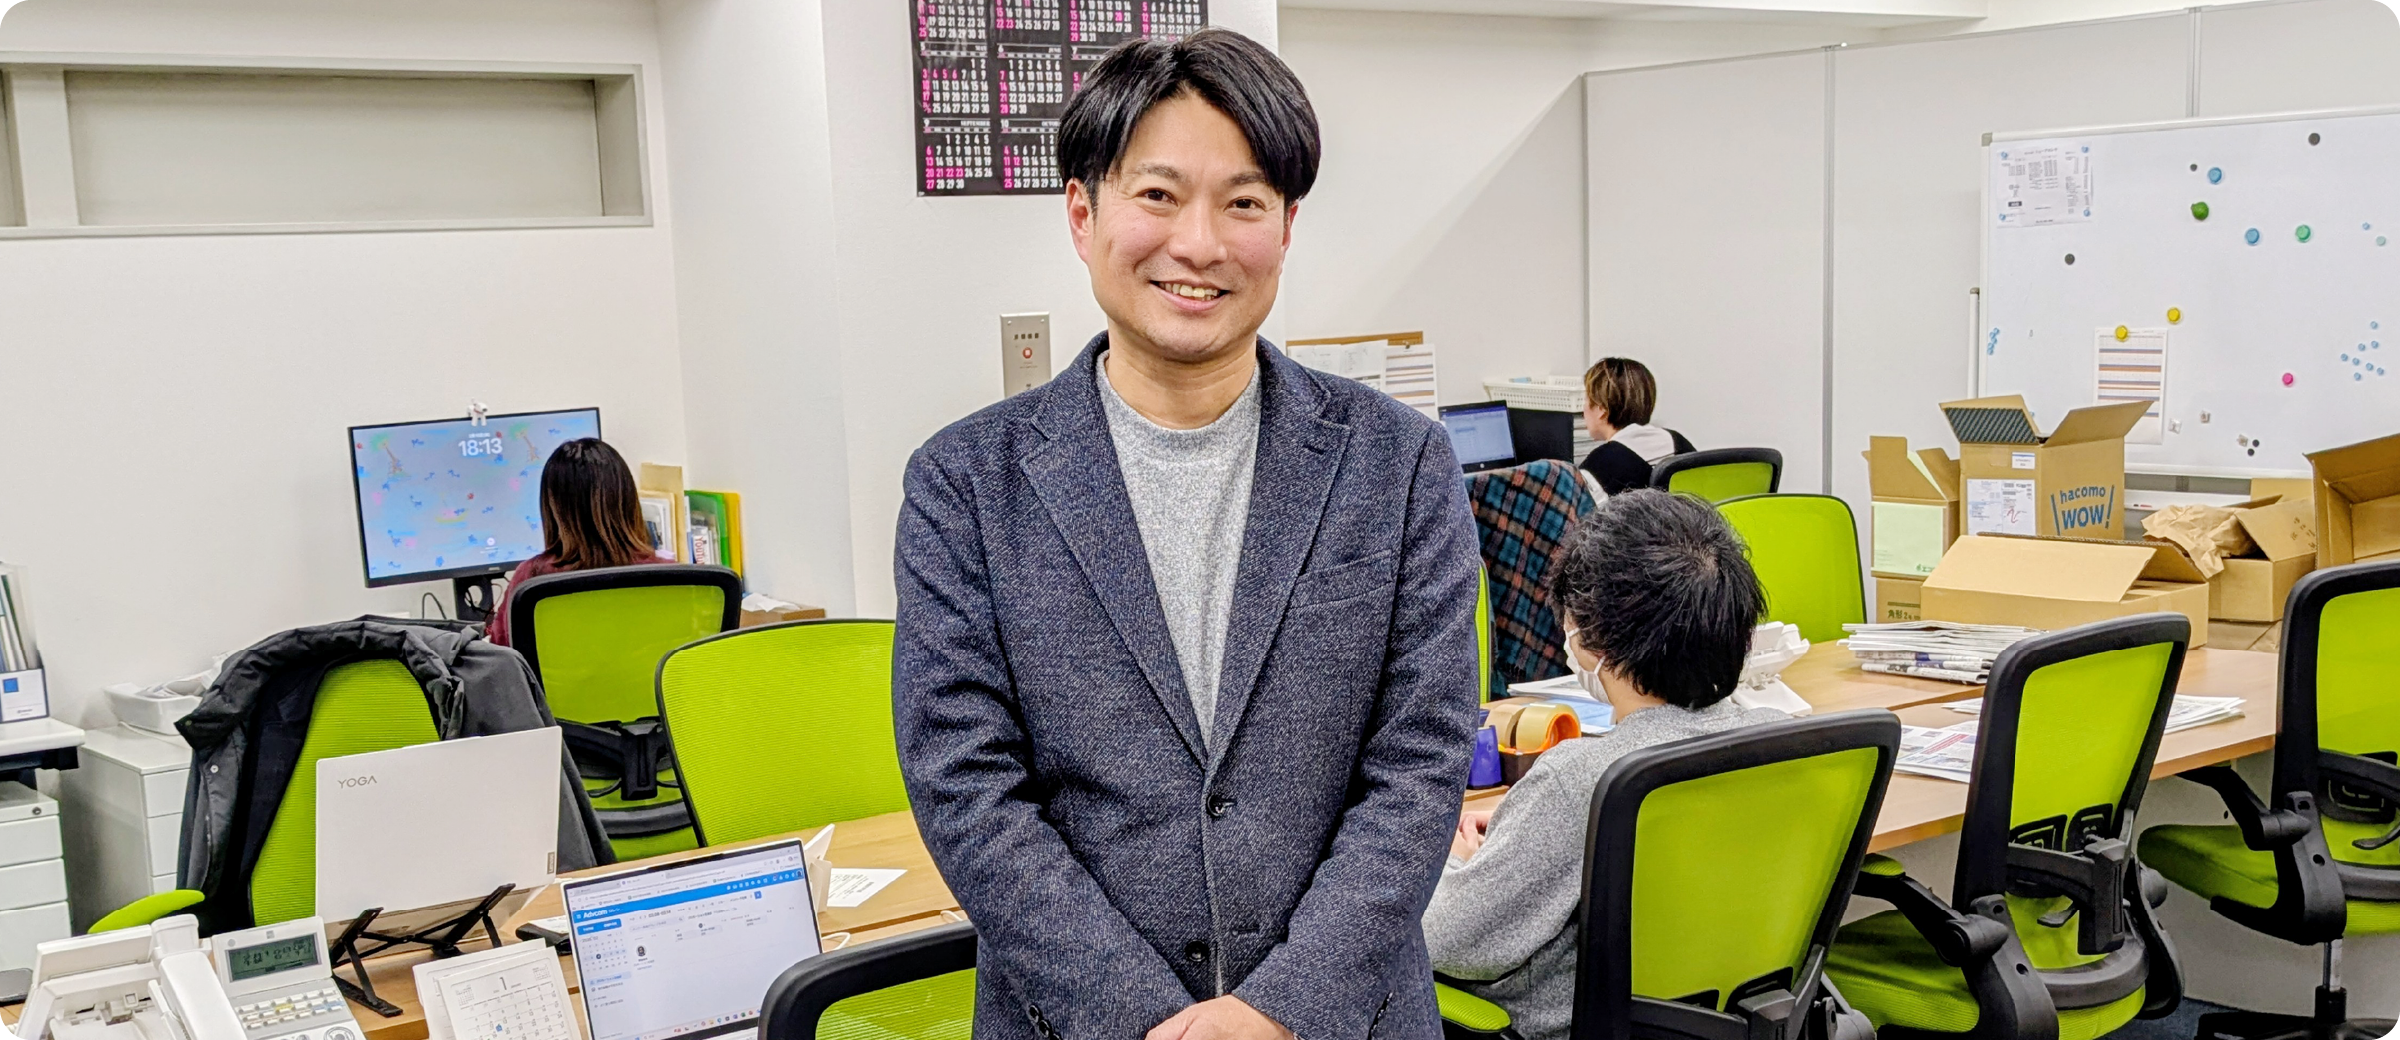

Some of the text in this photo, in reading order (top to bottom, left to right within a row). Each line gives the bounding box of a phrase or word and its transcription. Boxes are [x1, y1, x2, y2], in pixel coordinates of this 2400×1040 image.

[1070, 21, 1132, 32] 22 23 24 25 26 27 28
[1071, 32, 1096, 42] 29 30 31
[971, 58, 985, 69] 1 2
[1009, 60, 1060, 70] 1 2 3 4 5 6
[923, 69, 986, 80] 3 4 5 6 7 8 9
[1000, 71, 1062, 81] 7 8 9 10 11 12 13
[1073, 72, 1078, 81] 5
[923, 80, 988, 91] 10 11 12 13 14 15 16
[1000, 82, 1062, 92] 14 15 16 17 18 19 20
[923, 90, 988, 102] 17 18 19 20 21 22 23
[1000, 93, 1062, 103] 21 22 23 24 25 26 27
[933, 103, 941, 113] 25
[943, 103, 951, 113] 26
[952, 103, 960, 113] 27
[962, 103, 970, 113] 28
[972, 104, 979, 113] 29
[981, 104, 989, 113] 30
[1001, 104, 1027, 114] 28 29 30
[924, 119, 929, 127] 9
[1001, 119, 1009, 128] 10
[946, 134, 989, 144] 1 2 3 4 5
[1040, 135, 1054, 144] 1 2
[927, 145, 991, 155] 6 7 8 9 10 11 12
[1004, 145, 1054, 155] 4 5 6 7 8 9
[926, 156, 991, 166] 13 14 15 16 17 18 19
[1004, 156, 1010, 165] 11
[1014, 157, 1020, 166] 12
[1022, 156, 1029, 166] 13
[1031, 156, 1038, 165] 14
[1040, 156, 1047, 166] 15
[926, 168, 992, 177] 20 21 22 23 24 25 26
[1004, 168, 1011, 177] 18
[1014, 167, 1021, 176] 19
[1022, 168, 1030, 177] 20
[1031, 167, 1038, 177] 21
[1040, 167, 1048, 176] 22
[926, 179, 964, 189] 27 28 29 30
[1004, 178, 1058, 188] 25 26 27 28 29 30
[458, 438, 503, 456] 18:13
[2060, 486, 2105, 504] hacomo
[338, 775, 377, 789] YOGA
[583, 910, 607, 918] Advcom
